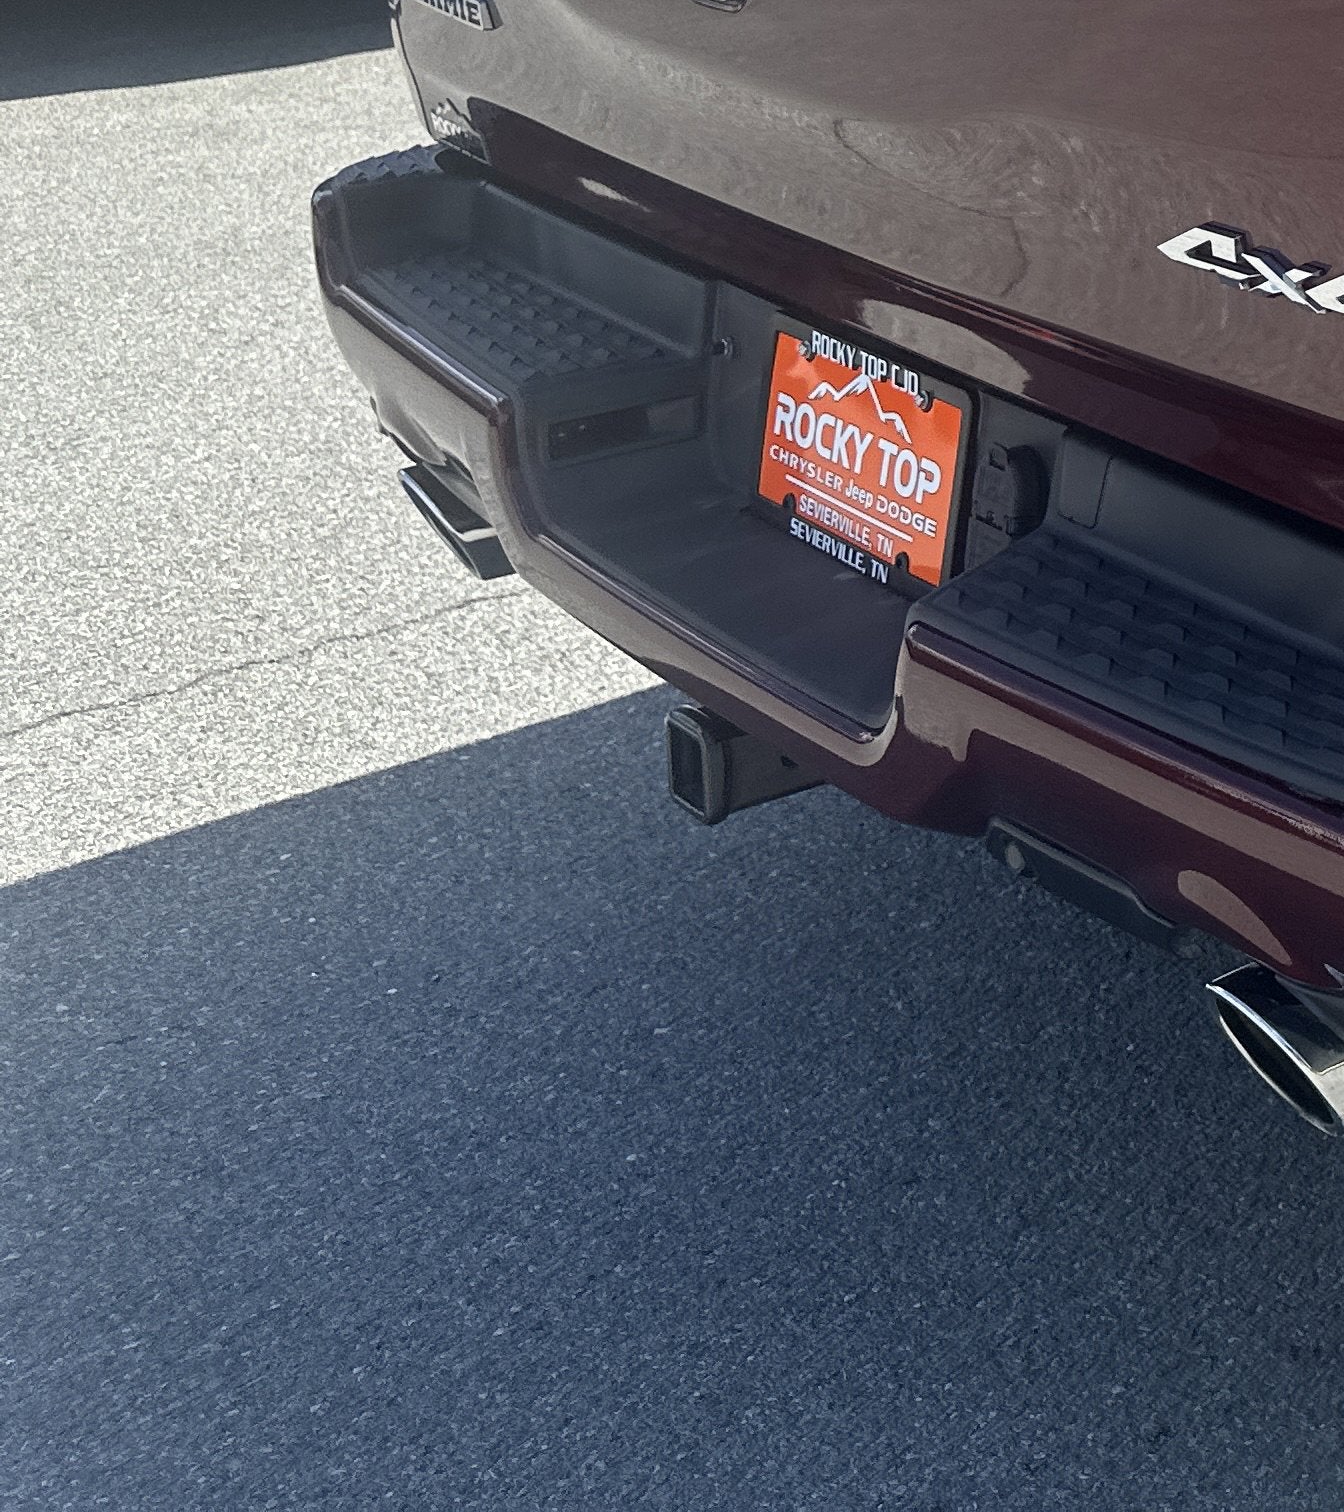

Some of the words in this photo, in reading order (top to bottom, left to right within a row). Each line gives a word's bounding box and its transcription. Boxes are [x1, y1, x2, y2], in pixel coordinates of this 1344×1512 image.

[811, 330, 856, 369] ROCKY
[860, 349, 888, 381] TOP
[890, 364, 919, 396] CJD
[773, 392, 875, 475] ROCKY
[878, 437, 942, 504] TOP
[769, 444, 844, 487] CHRYSLER
[845, 478, 874, 509] Jeep
[876, 493, 938, 538] DODGE
[789, 516, 868, 575] SEVIERVILLE,
[870, 558, 890, 585] TN
[798, 493, 873, 551] SEVIERVILLE,
[876, 533, 895, 559] TN
